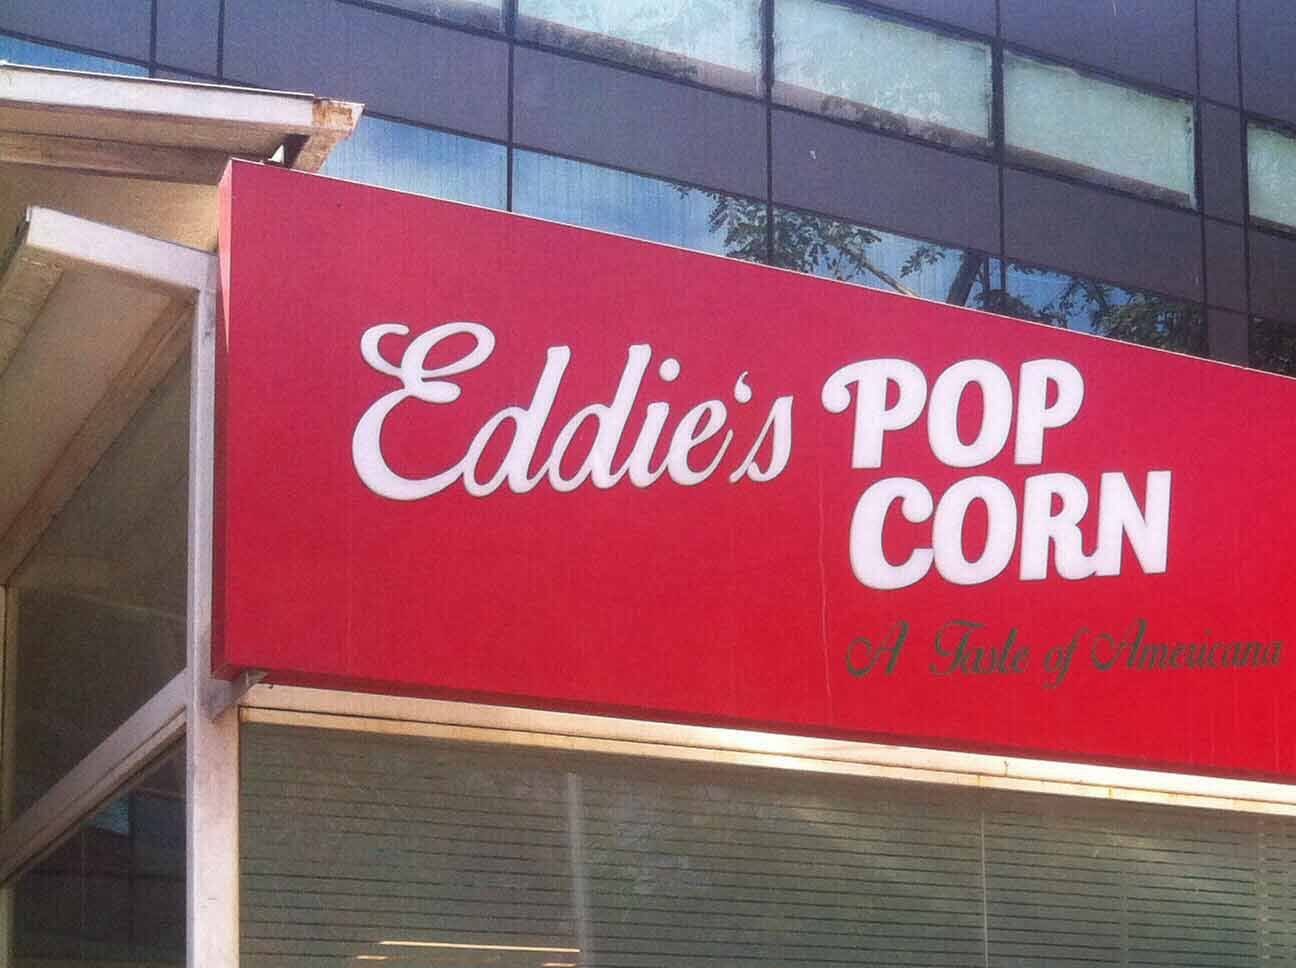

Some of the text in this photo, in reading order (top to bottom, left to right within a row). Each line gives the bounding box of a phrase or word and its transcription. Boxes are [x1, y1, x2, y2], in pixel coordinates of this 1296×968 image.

[352, 321, 1085, 501] Eddie's POP
[848, 470, 1173, 591] CORN
[845, 616, 1284, 690] A Taste of Americana
